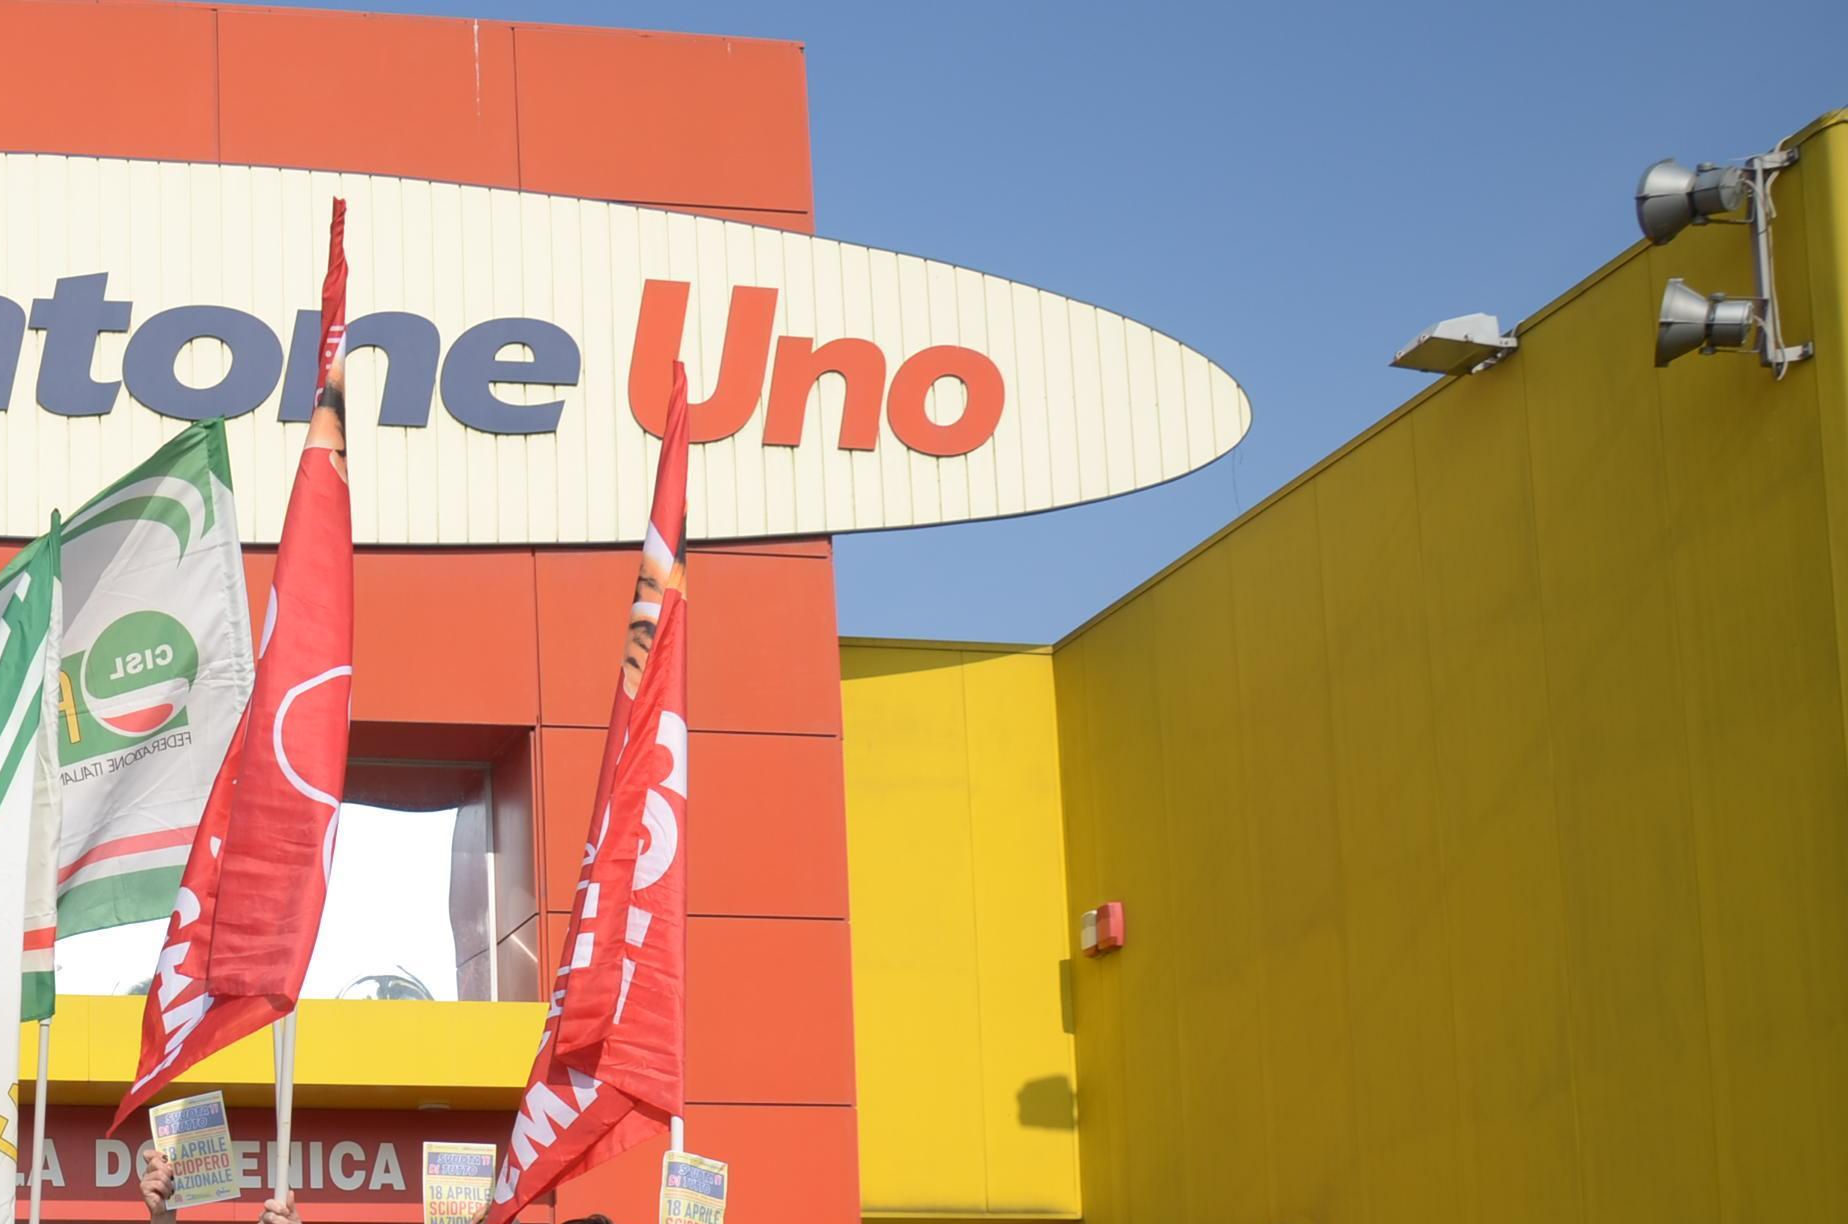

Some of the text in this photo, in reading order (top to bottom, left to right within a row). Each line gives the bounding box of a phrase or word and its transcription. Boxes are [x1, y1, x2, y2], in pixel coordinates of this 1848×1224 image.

[626, 279, 1005, 457] Uno
[181, 1137, 227, 1160] APRILE
[172, 1153, 230, 1176] CIOPERO
[430, 1185, 443, 1200] 18
[666, 1199, 682, 1217] 18
